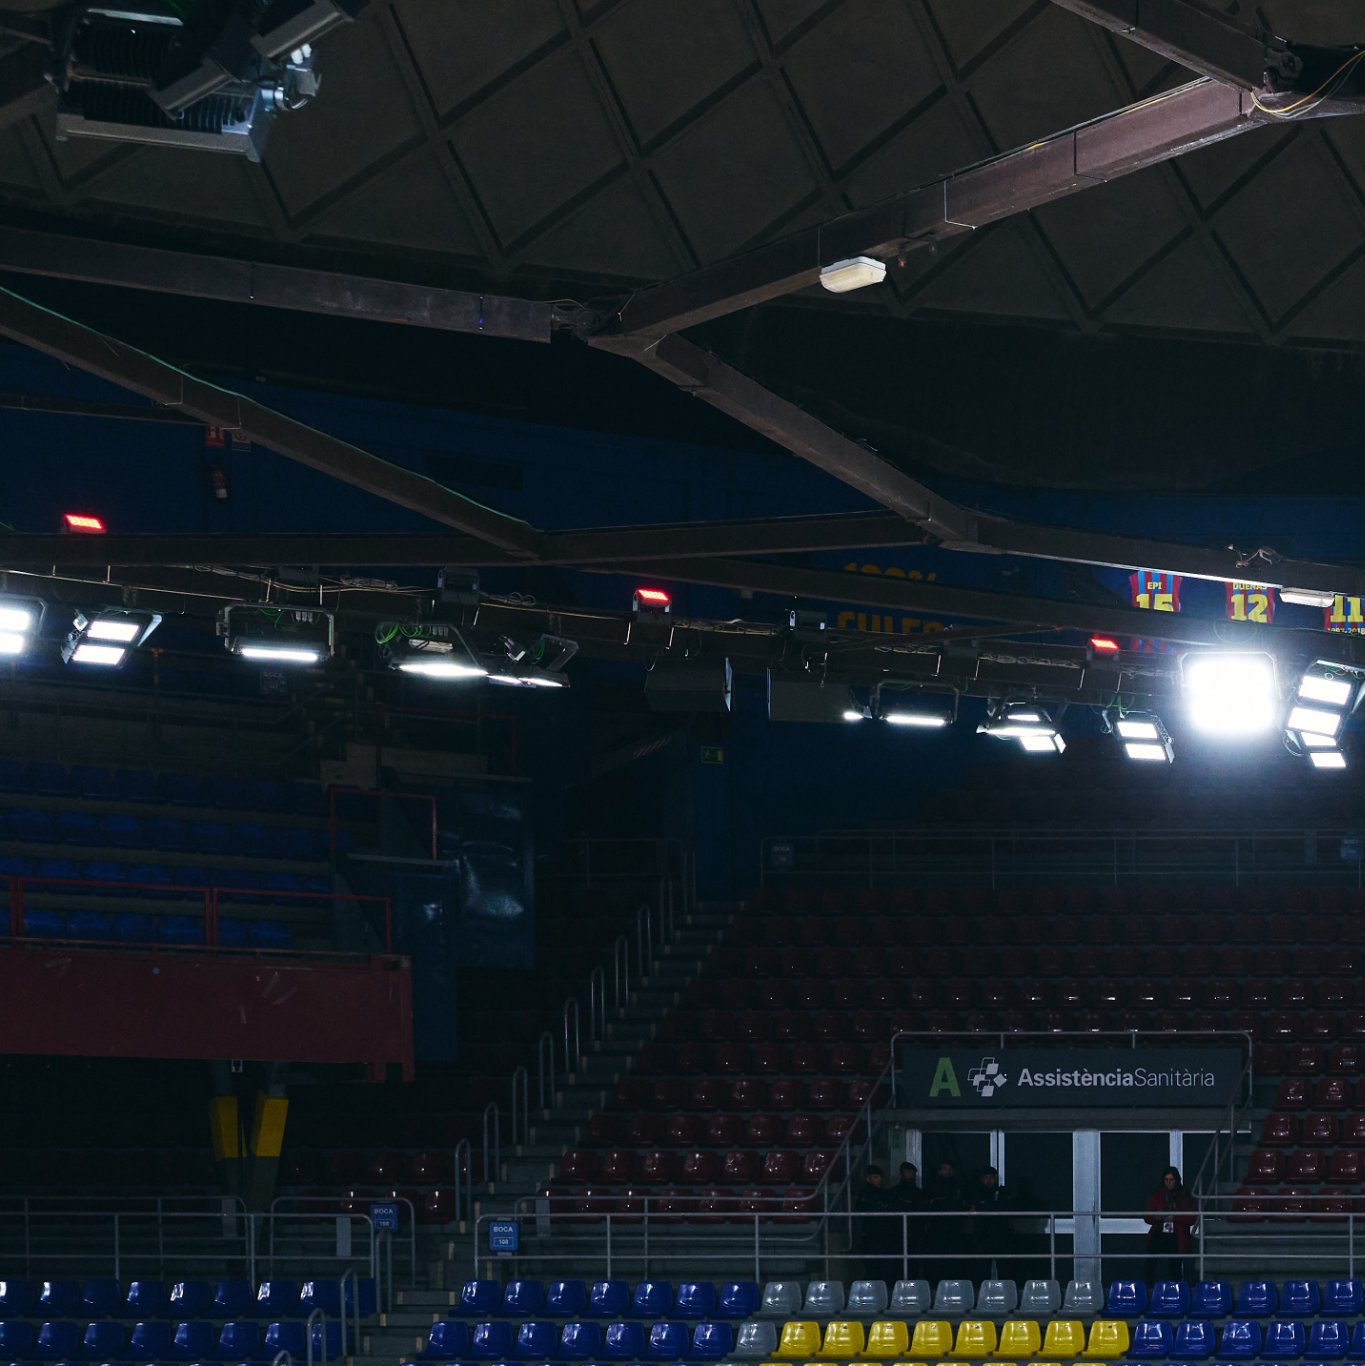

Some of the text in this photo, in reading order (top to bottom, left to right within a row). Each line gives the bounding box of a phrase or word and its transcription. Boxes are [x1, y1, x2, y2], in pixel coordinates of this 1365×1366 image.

[1148, 582, 1162, 590] EPI
[1231, 594, 1268, 623] 12
[1330, 596, 1363, 622] 11
[930, 1057, 961, 1096] A
